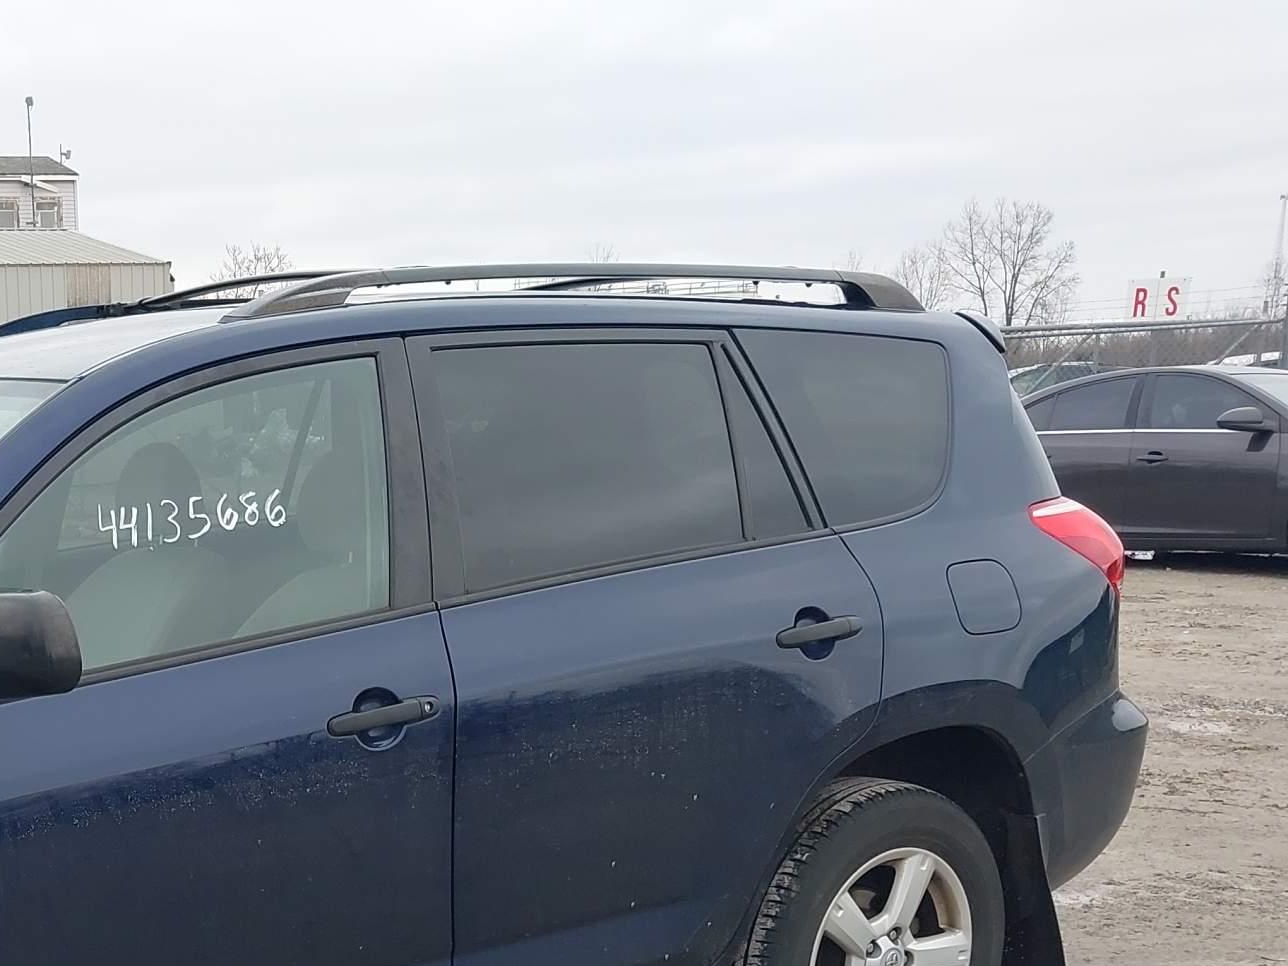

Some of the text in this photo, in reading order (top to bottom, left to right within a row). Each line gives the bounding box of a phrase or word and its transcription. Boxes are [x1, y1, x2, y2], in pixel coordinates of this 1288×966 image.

[1132, 286, 1180, 318] R S
[97, 488, 287, 550] 44135686
